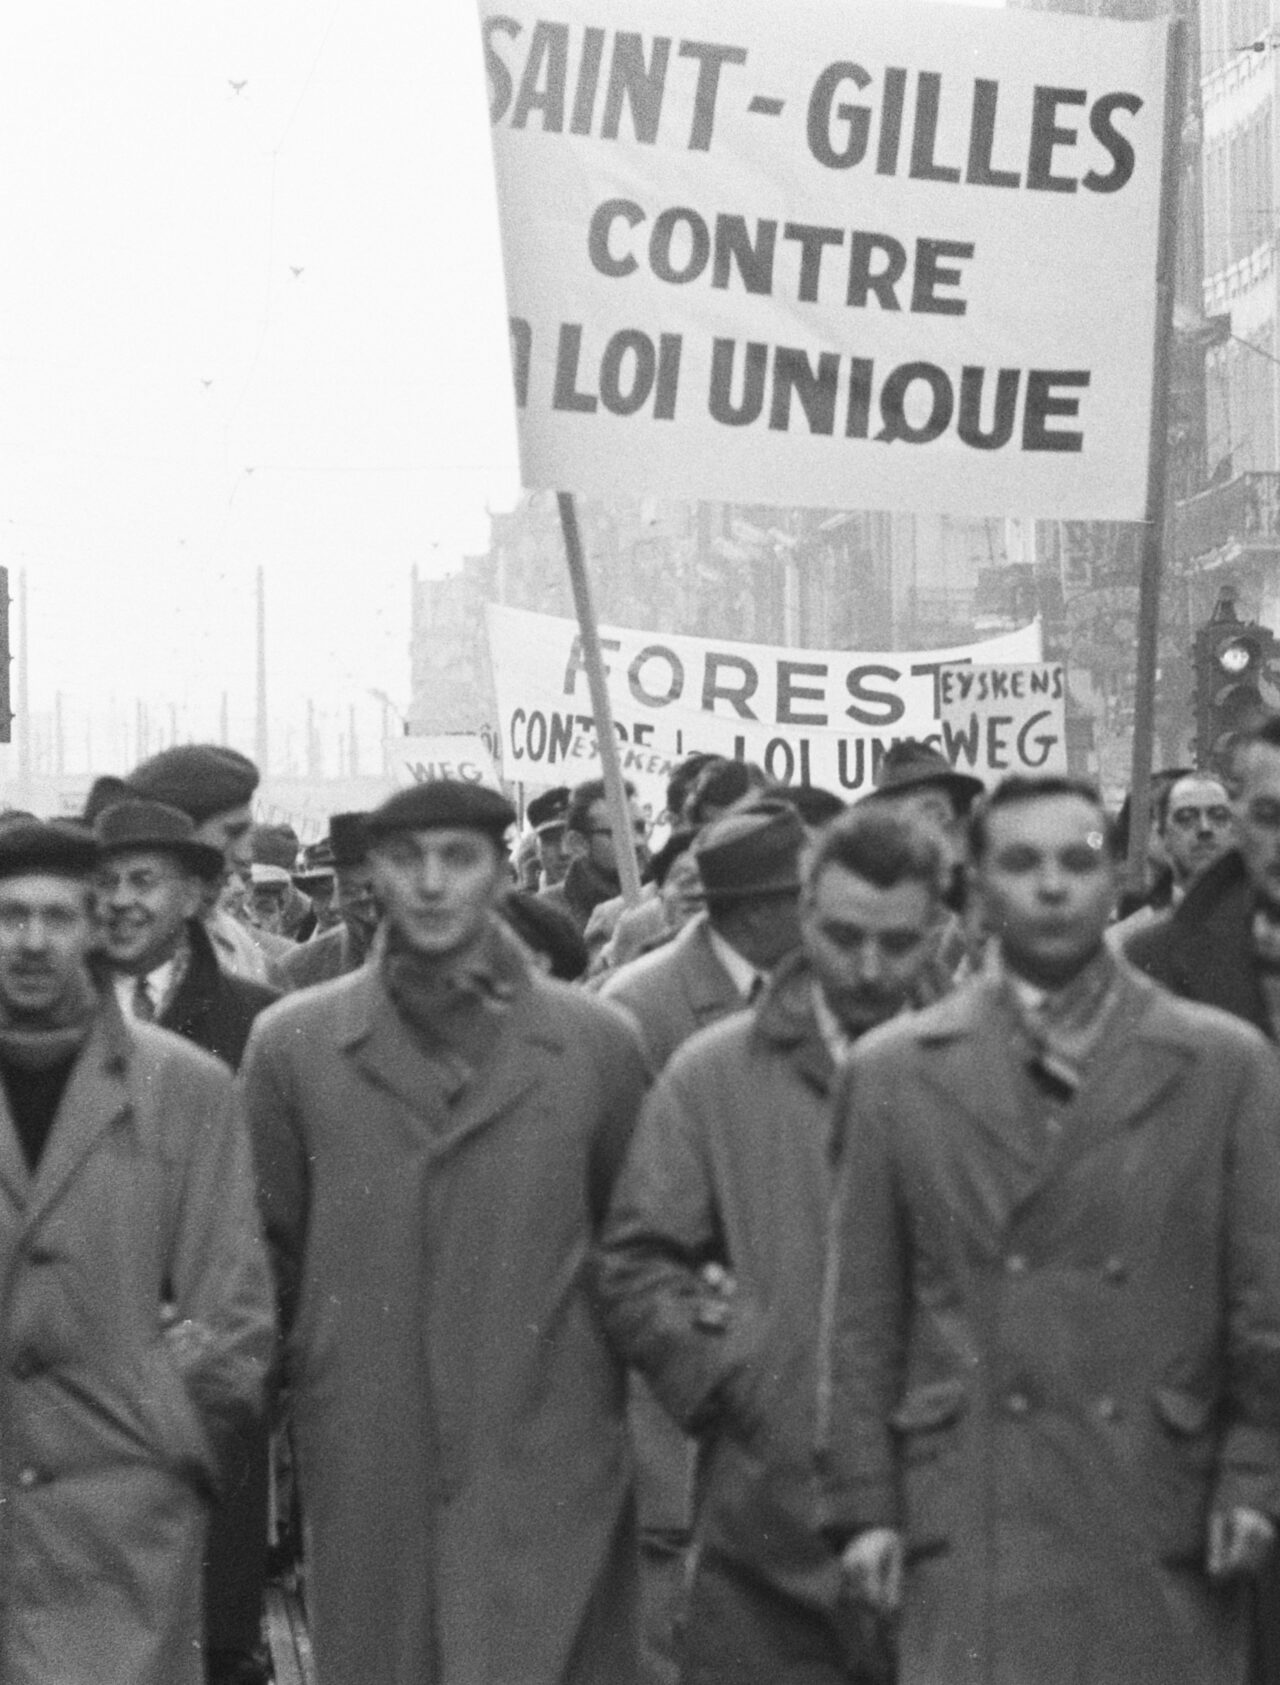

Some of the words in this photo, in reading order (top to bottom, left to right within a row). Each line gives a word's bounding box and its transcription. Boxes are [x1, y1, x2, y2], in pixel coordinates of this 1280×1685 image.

[587, 198, 976, 317] CONTRE
[552, 322, 684, 421] LOI
[707, 337, 1092, 453] UNIQUE
[563, 633, 972, 727] FOREST
[941, 667, 1063, 705] EYSKENS
[942, 711, 1059, 770] WEG
